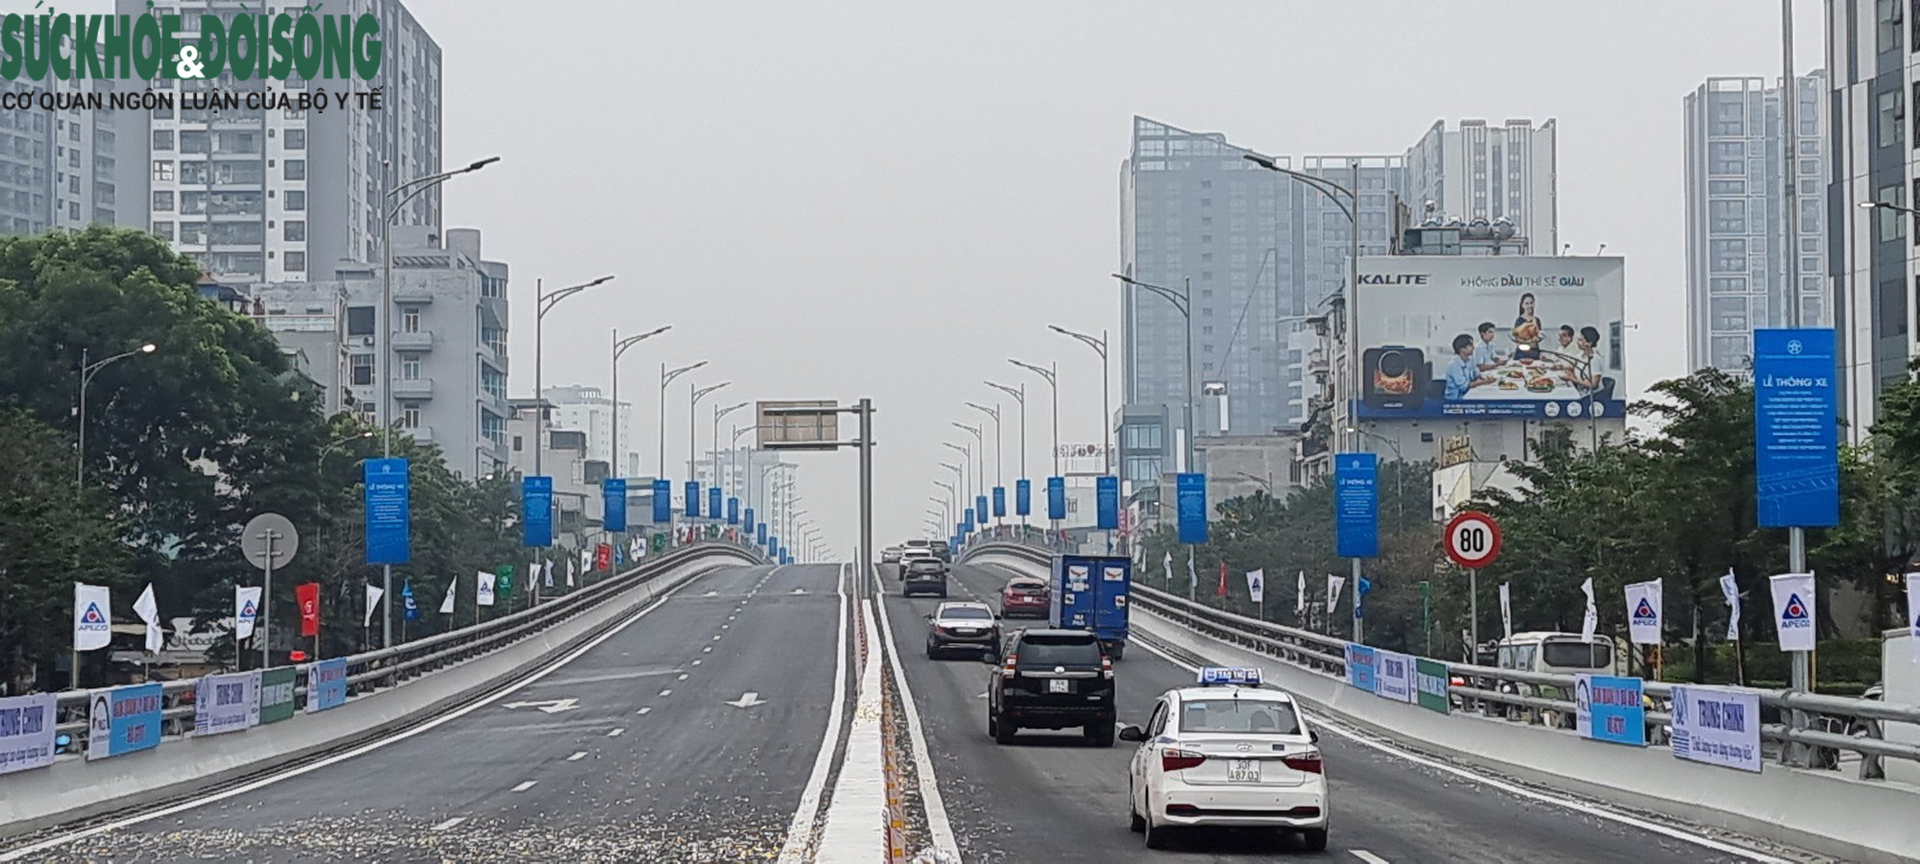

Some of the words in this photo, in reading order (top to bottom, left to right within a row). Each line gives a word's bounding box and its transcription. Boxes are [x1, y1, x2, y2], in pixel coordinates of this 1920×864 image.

[1357, 274, 1428, 285] KALITE
[1460, 276, 1499, 288] KHÔNG
[1501, 273, 1522, 287] DẦU
[1774, 375, 1813, 387] THÔNG
[1460, 528, 1484, 553] 80
